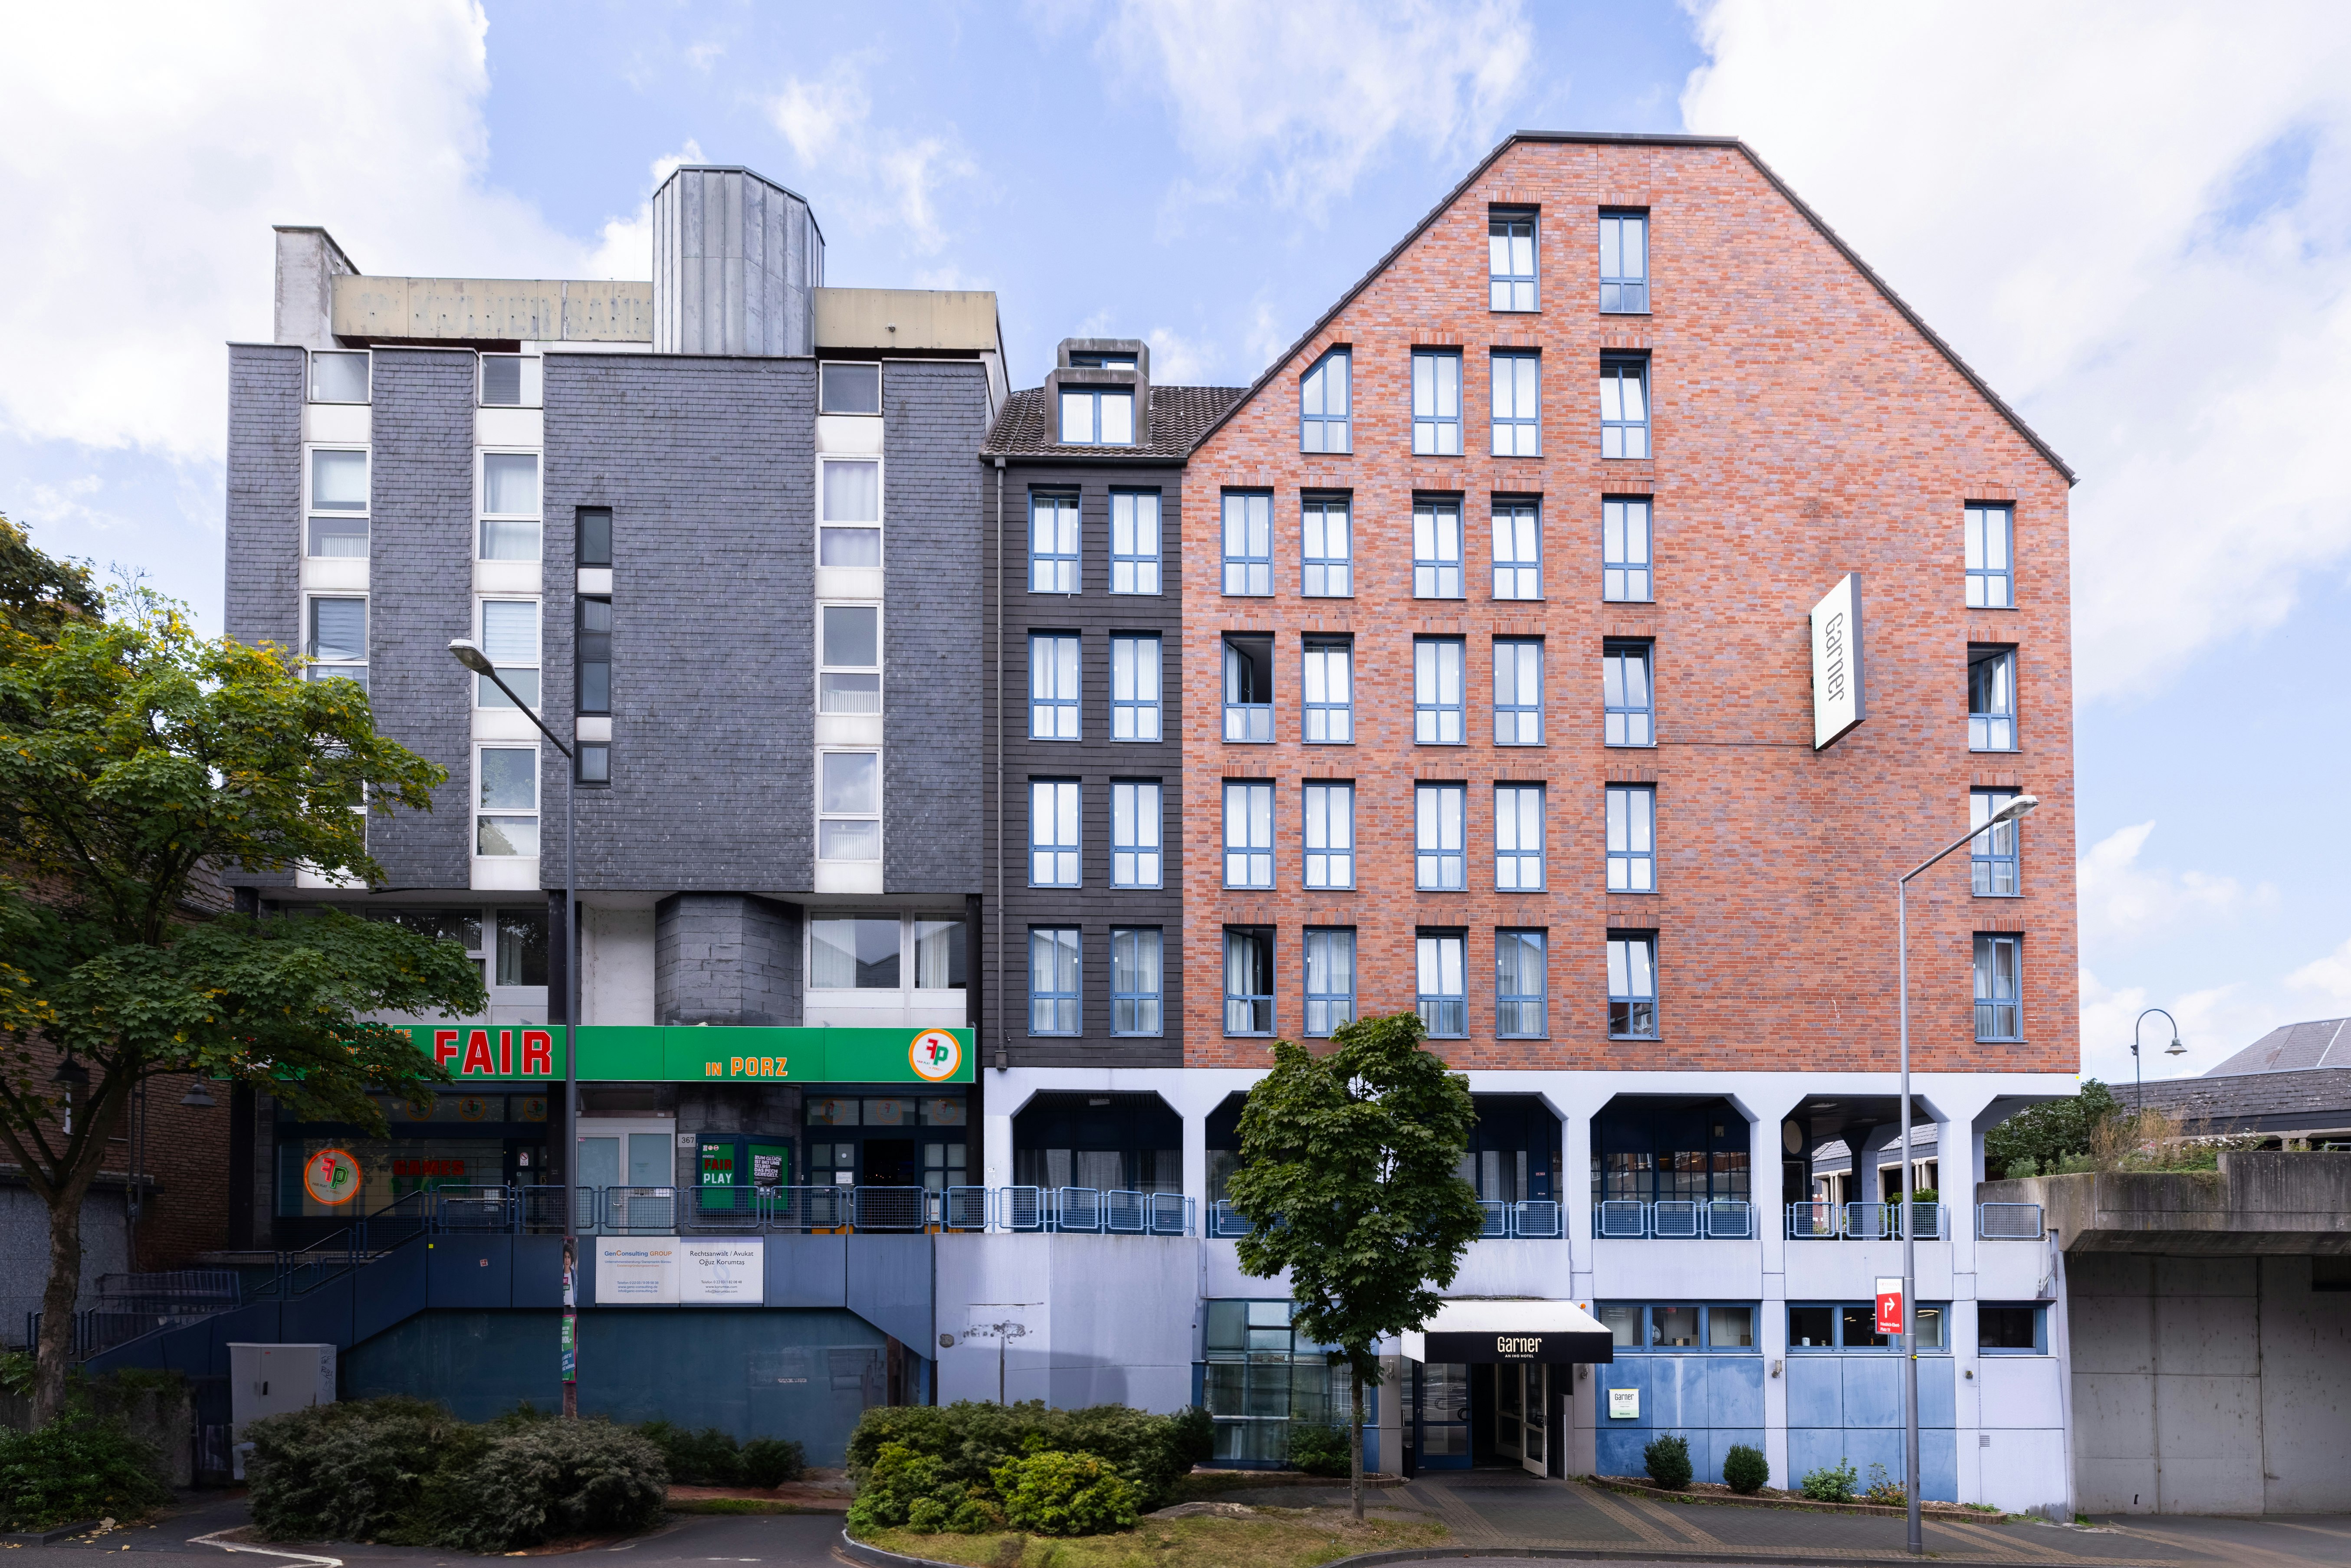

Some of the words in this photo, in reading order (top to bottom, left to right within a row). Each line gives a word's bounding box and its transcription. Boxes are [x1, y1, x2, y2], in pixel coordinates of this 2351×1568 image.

[1826, 612, 1844, 702] Garner
[434, 1030, 552, 1075] FAIR
[706, 1063, 722, 1076] IN
[731, 1057, 788, 1076] PORZ
[393, 1160, 464, 1175] GAMES
[704, 1159, 732, 1170] FAIR
[703, 1173, 732, 1184] PLAY
[1497, 1336, 1542, 1352] Garner
